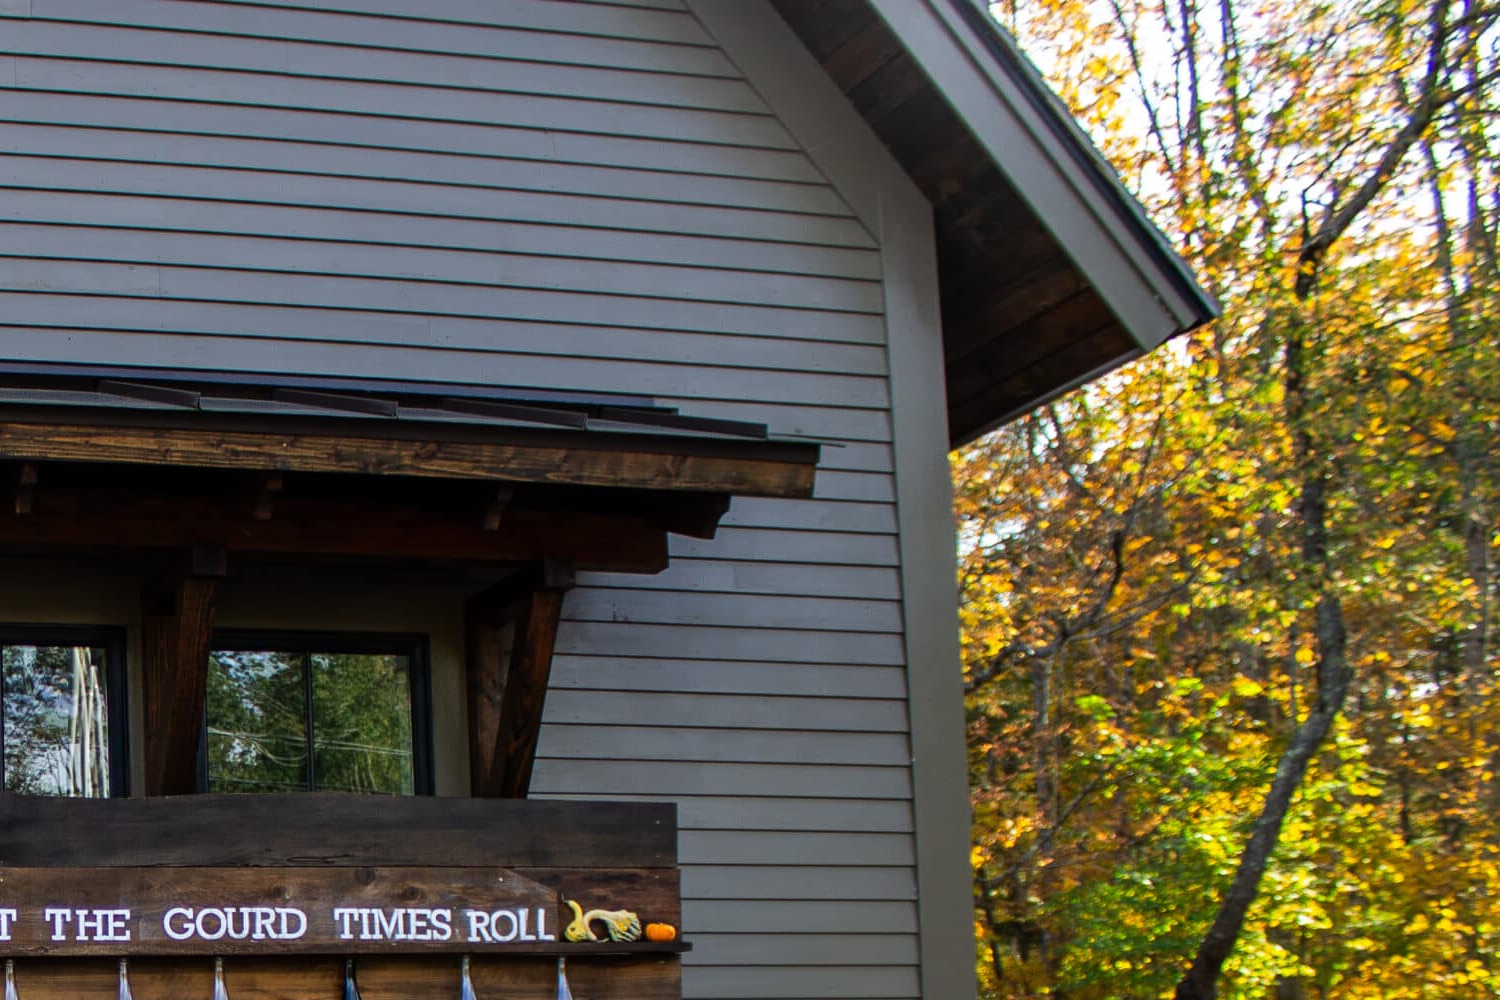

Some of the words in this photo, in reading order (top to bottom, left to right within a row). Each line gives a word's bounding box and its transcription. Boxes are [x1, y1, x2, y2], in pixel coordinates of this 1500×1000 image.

[44, 907, 131, 941] THE
[163, 906, 308, 940] GOURD
[333, 907, 452, 941] TIMES
[466, 908, 555, 942] ROLL
